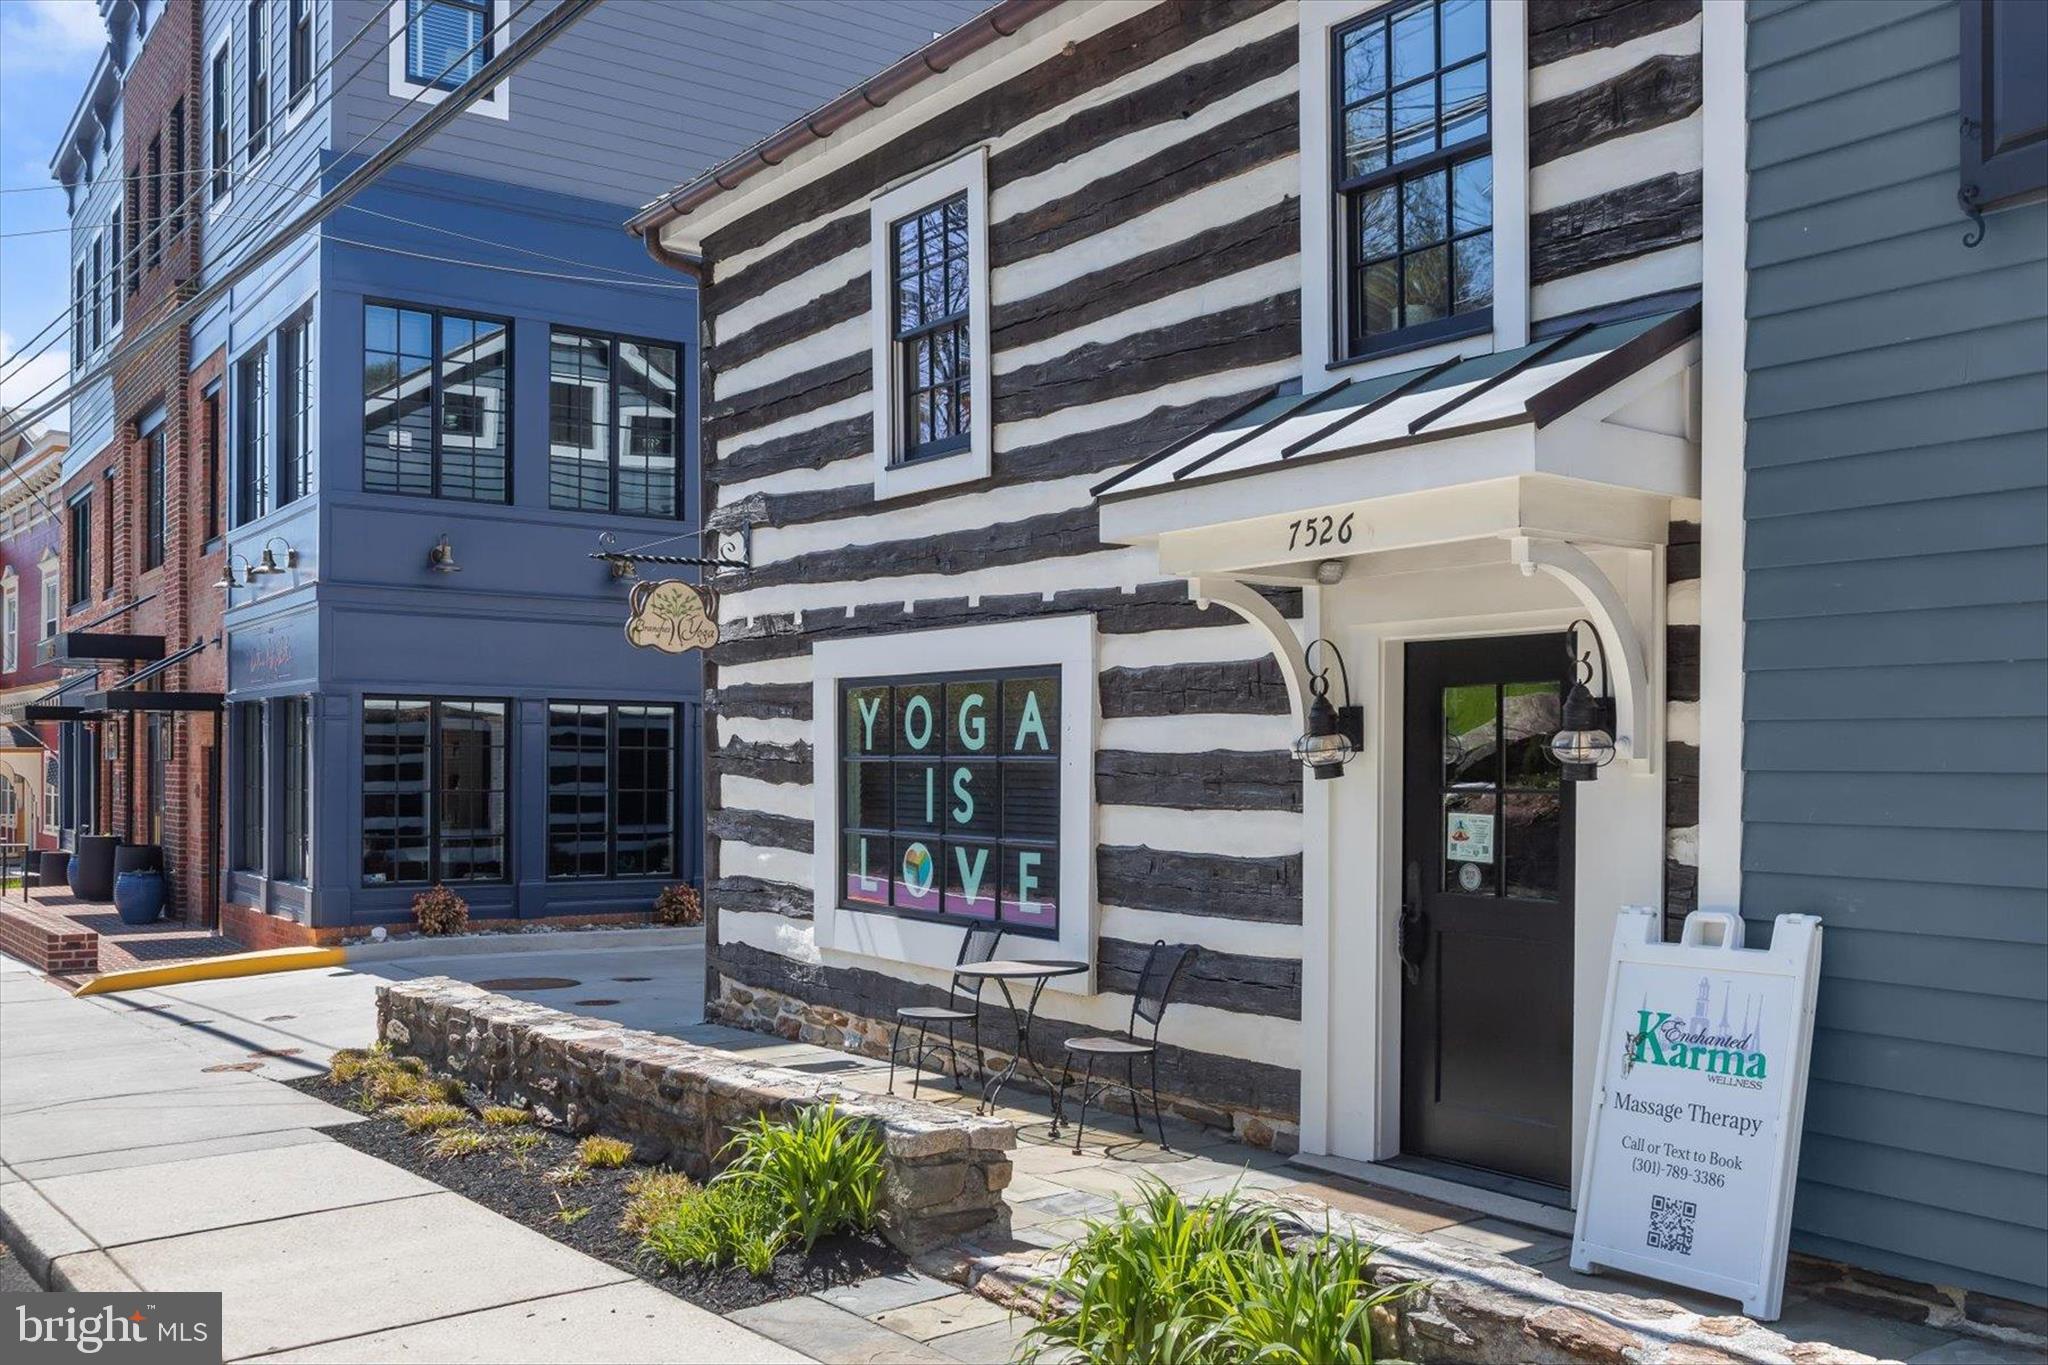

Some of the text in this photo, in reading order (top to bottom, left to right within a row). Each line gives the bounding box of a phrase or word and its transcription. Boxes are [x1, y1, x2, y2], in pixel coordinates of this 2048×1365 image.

[1289, 512, 1354, 551] 7526
[681, 613, 715, 644] Yoga
[858, 691, 1049, 750] YOGA
[926, 767, 974, 823] IS
[860, 838, 1042, 914] LOVE
[1633, 1010, 1767, 1079] Karma
[1661, 1019, 1752, 1050] Enchanted
[1707, 1074, 1763, 1090] WELLNESS
[1614, 1091, 1763, 1136] Massage Therapy
[1621, 1135, 1743, 1170] Call or Text to Book
[1632, 1156, 1726, 1188] (301)-789-3386
